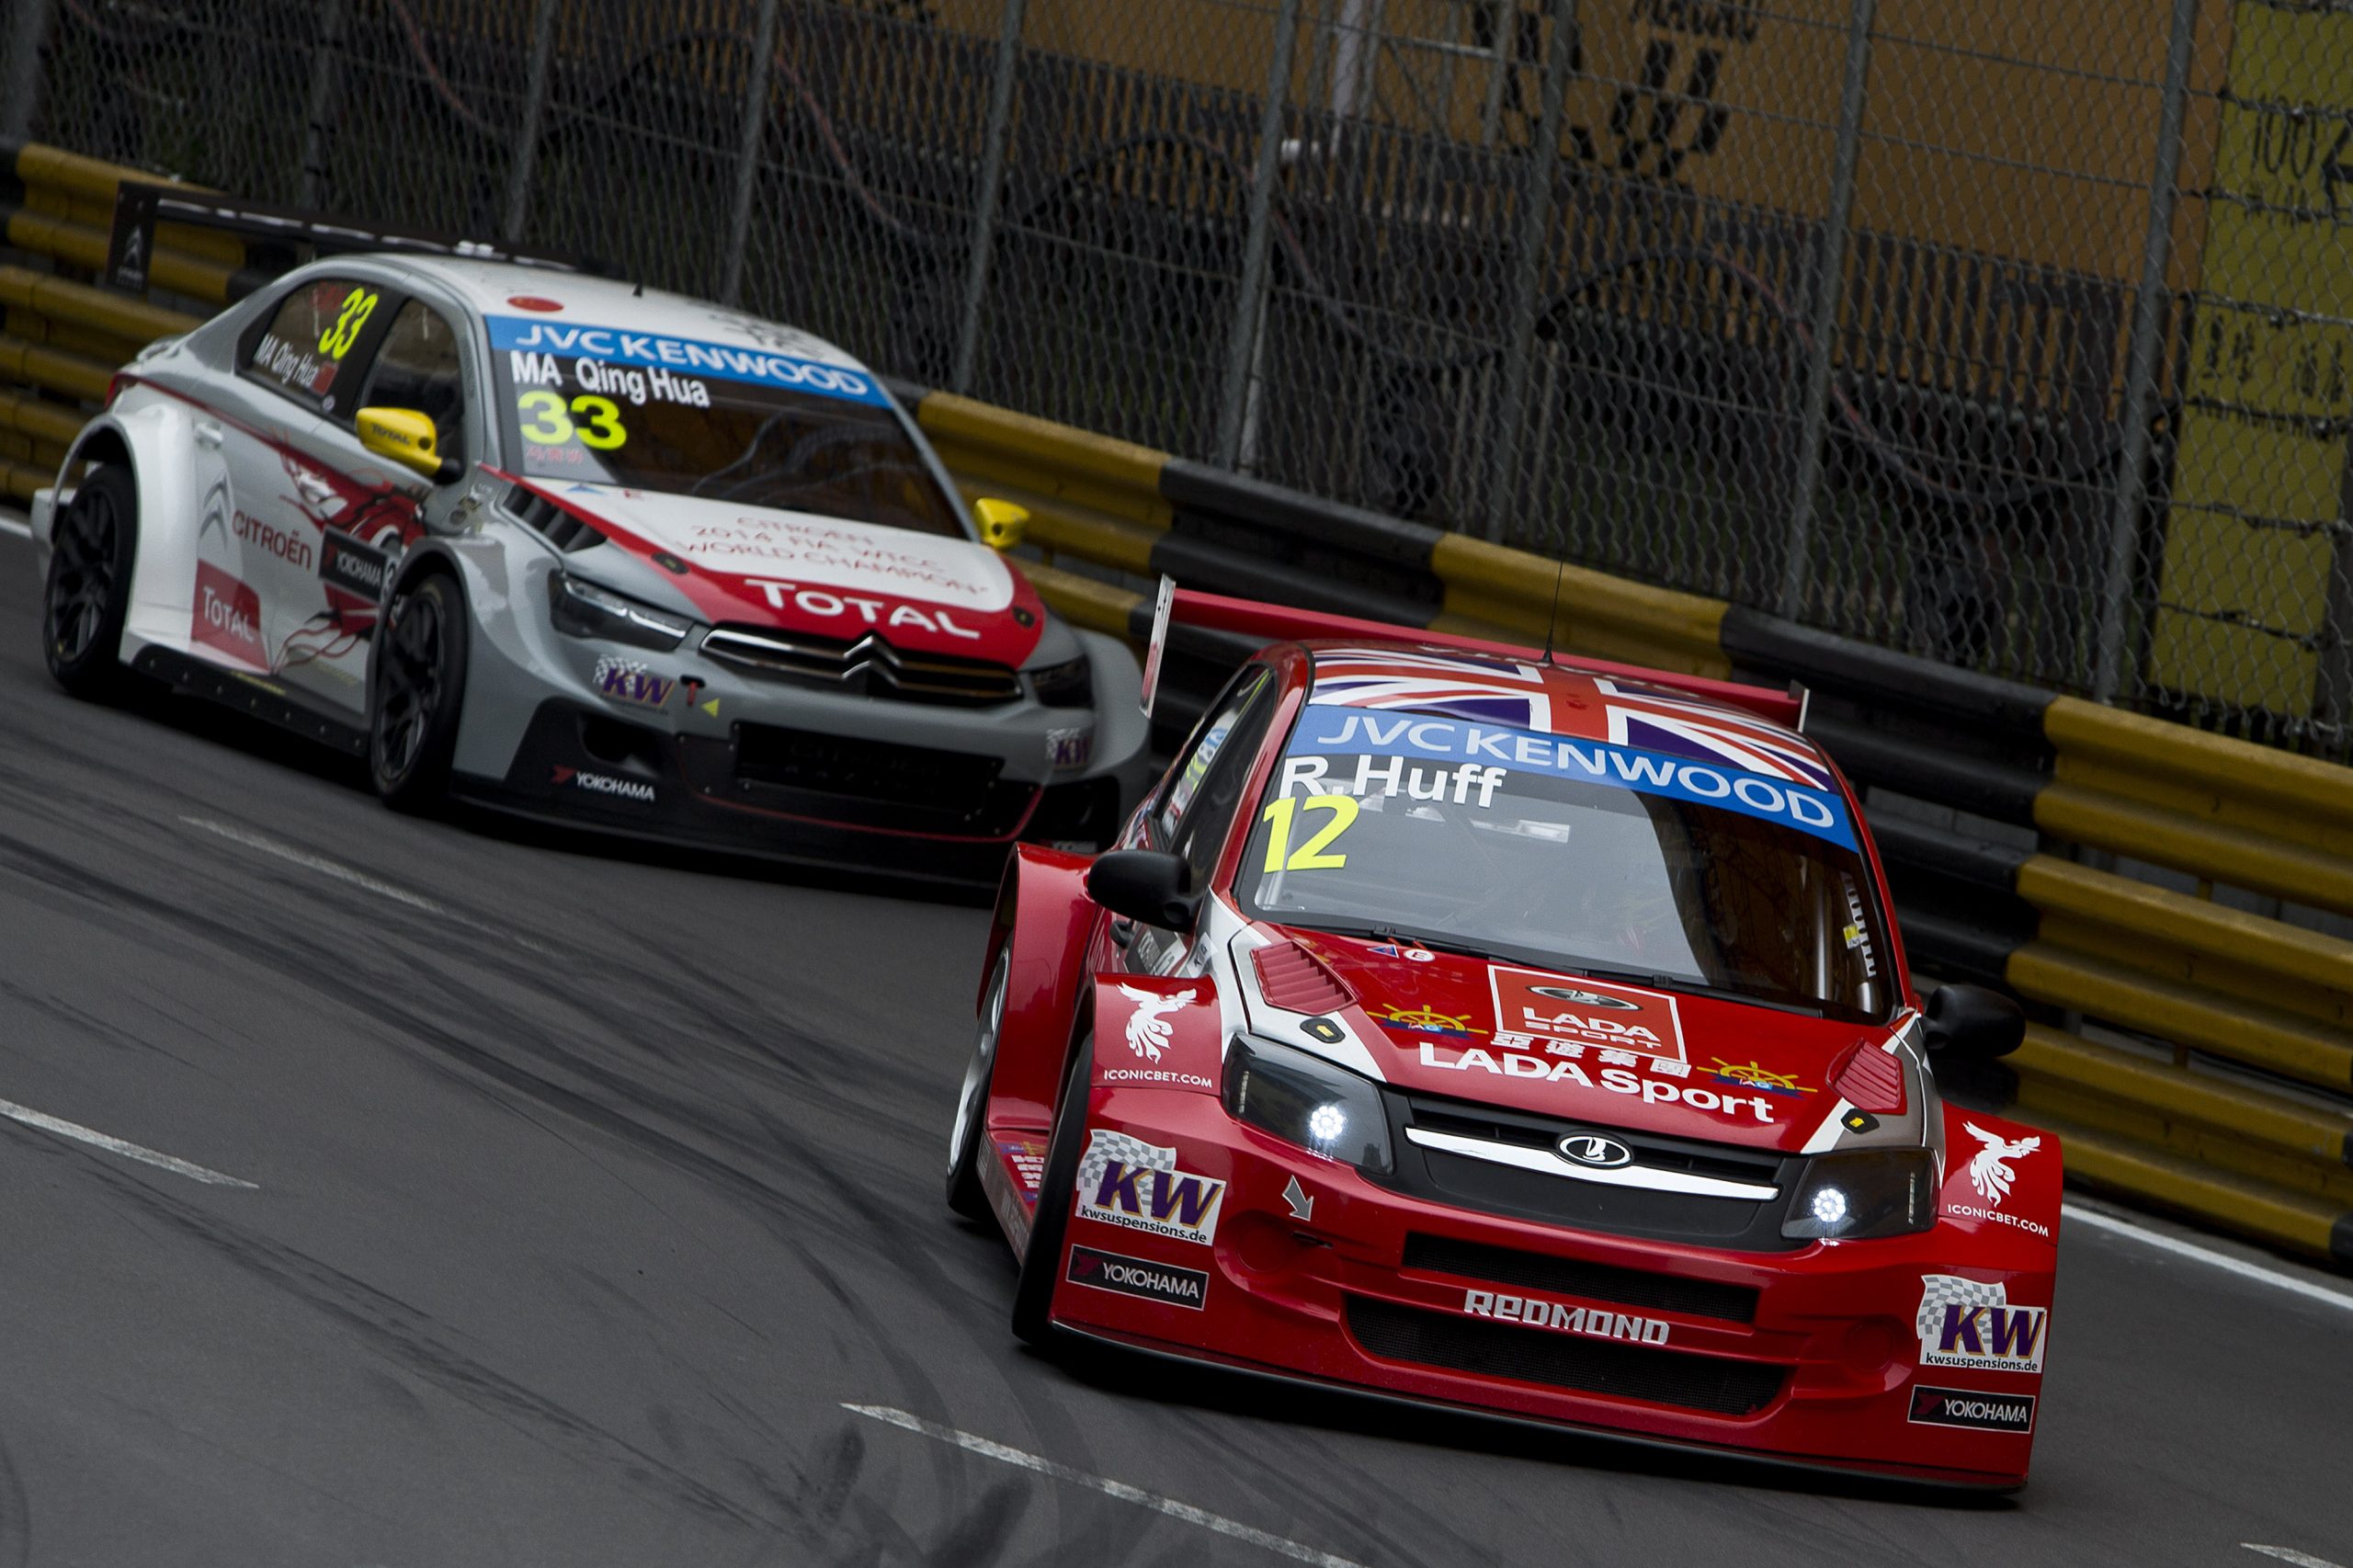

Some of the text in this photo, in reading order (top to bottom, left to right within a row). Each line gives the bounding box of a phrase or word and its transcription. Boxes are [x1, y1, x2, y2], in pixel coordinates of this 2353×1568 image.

[318, 287, 379, 361] 33
[253, 332, 320, 388] MA Qing Hua
[510, 348, 710, 408] MA Qing Hua
[516, 324, 869, 396] JVCKENWOOD
[517, 389, 629, 450] 33
[744, 577, 982, 642] TOTAL
[603, 667, 676, 707] KW
[576, 770, 656, 802] YOKOHAMA
[1317, 715, 1836, 828] JVCKENWOOD
[1263, 794, 1360, 874] 12
[1522, 1006, 1662, 1042] LADA
[1524, 1020, 1663, 1050] SPORT
[1104, 1068, 1212, 1089] ICONICBET.COM
[1418, 1040, 1775, 1123] LADA Sport
[1095, 1159, 1223, 1230] KW
[1947, 1203, 2050, 1238] ICONICBET.COM
[1081, 1204, 1208, 1244] kwsuspensions.de
[1103, 1261, 1199, 1300] YOKOHAMA
[1938, 1303, 2047, 1360] KW
[1925, 1352, 2039, 1372] kwsuspensions.de
[1944, 1398, 2028, 1424] YOKOHAMA
